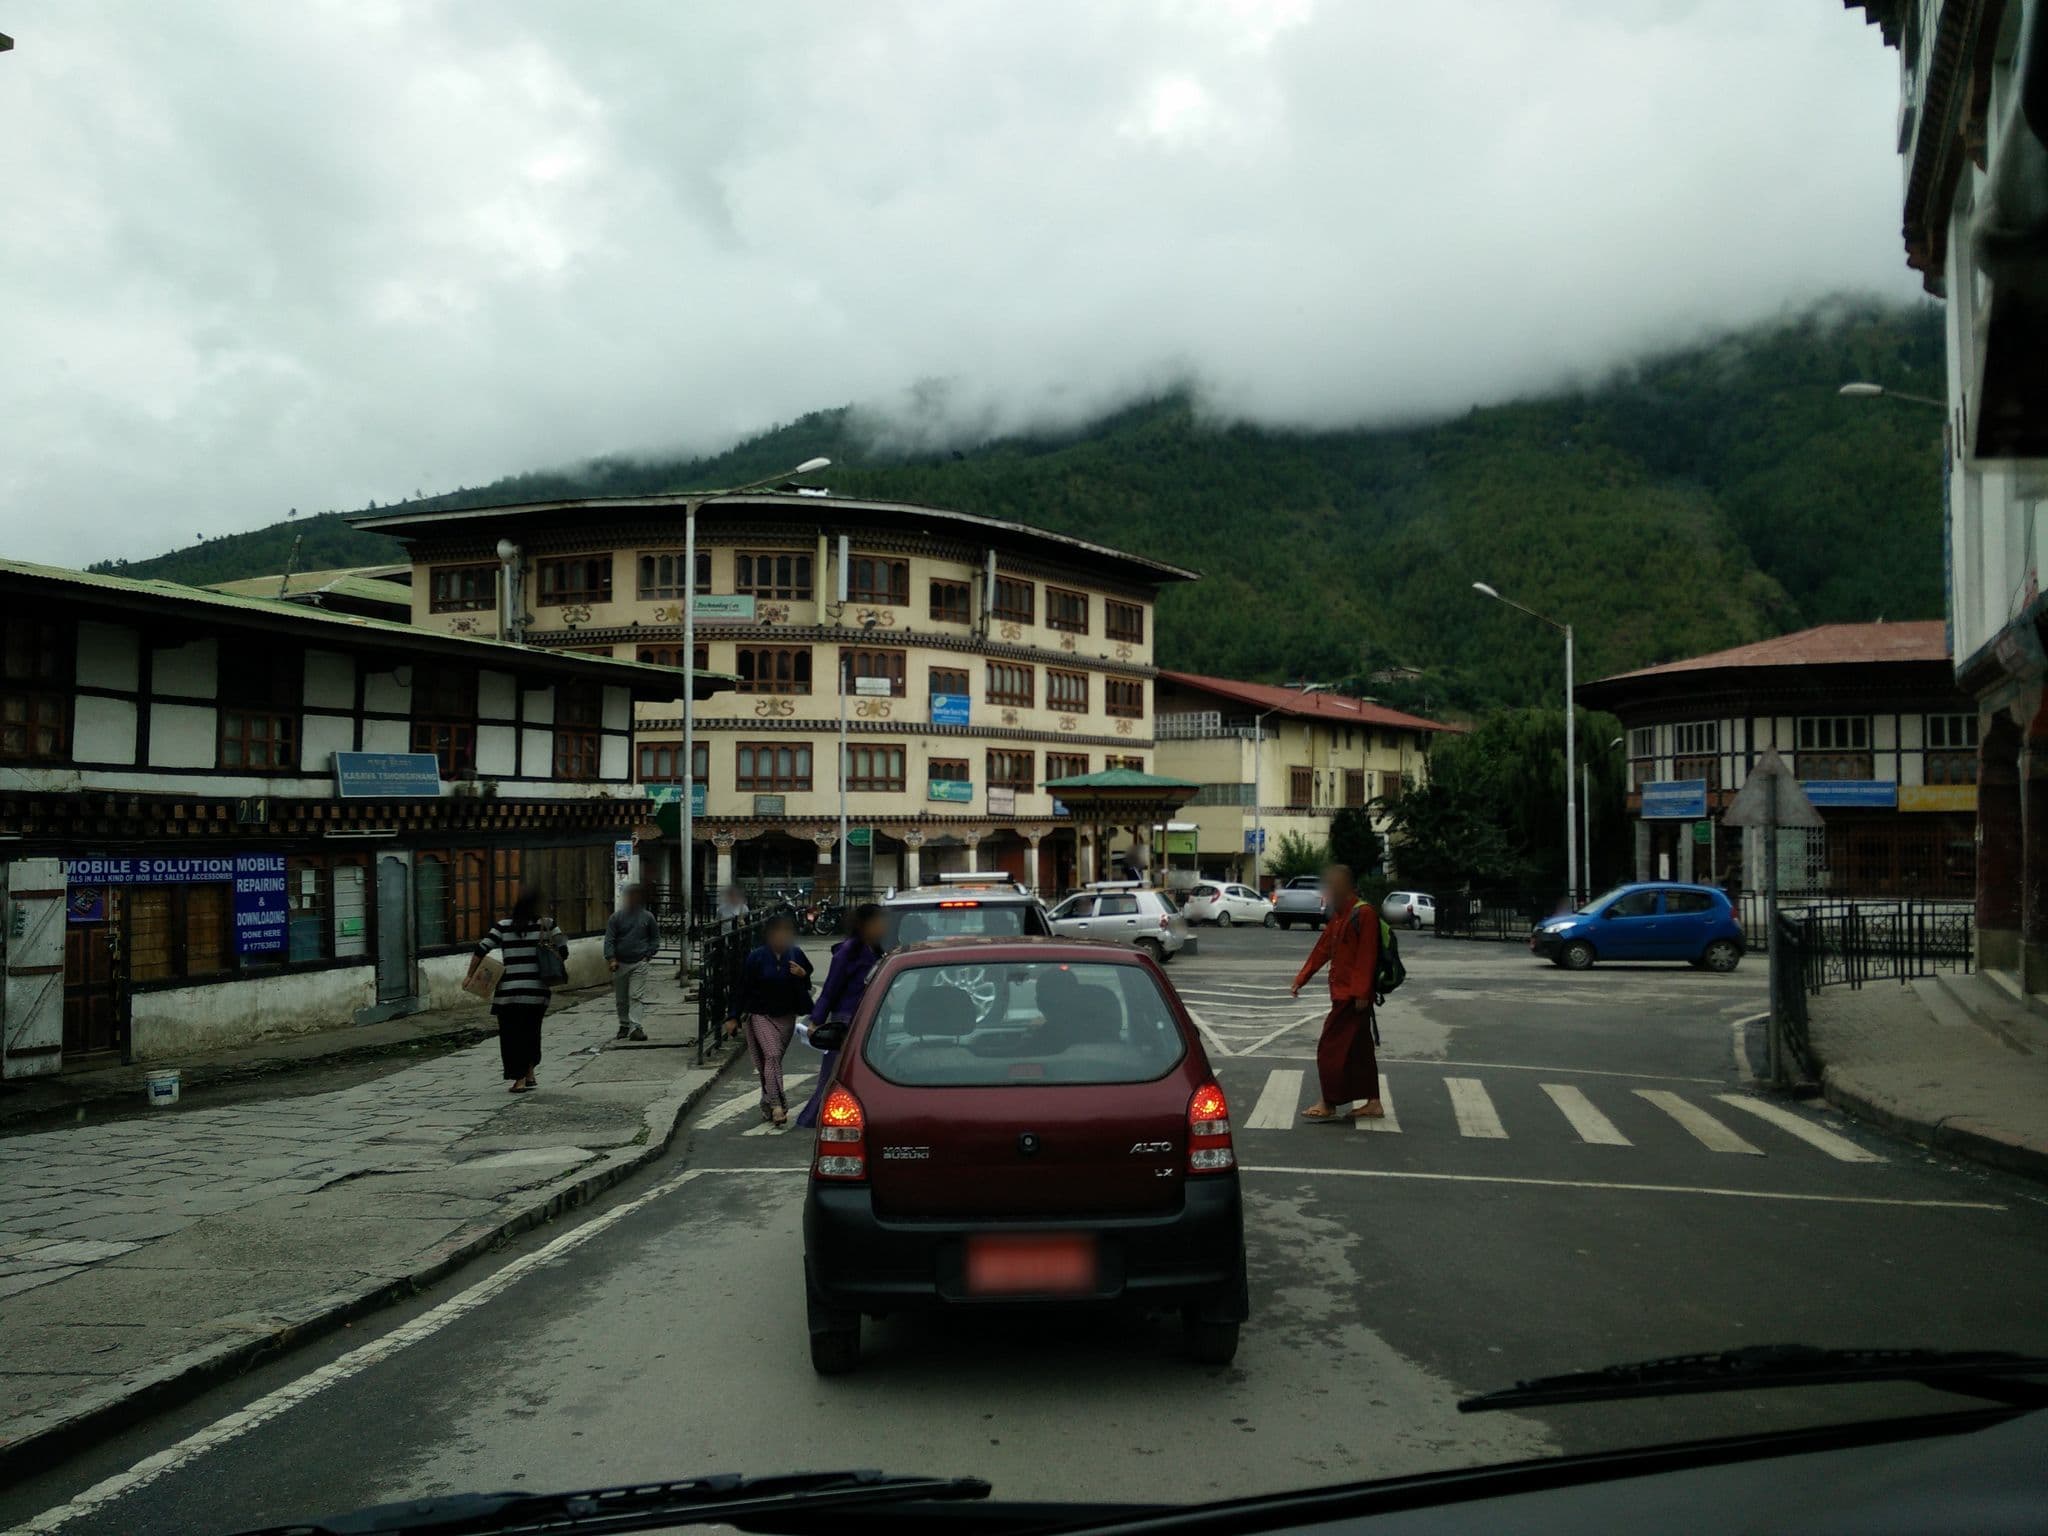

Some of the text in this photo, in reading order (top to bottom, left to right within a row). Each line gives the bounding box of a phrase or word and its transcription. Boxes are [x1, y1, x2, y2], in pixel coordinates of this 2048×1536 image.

[66, 860, 131, 874] MOBILE
[237, 857, 285, 872] MOBILE
[67, 874, 83, 883] EALS
[93, 874, 107, 882] ALL
[107, 873, 124, 882] KIND
[164, 872, 184, 881] SALES
[191, 872, 233, 881] ACCESSORIES
[237, 878, 285, 893] REPAIRING
[258, 896, 266, 907] &
[237, 911, 286, 926] DOWNLOADING
[242, 929, 282, 939] DONE HERE
[1128, 1141, 1174, 1154] ALTO
[882, 1151, 931, 1160] SUZUKI
